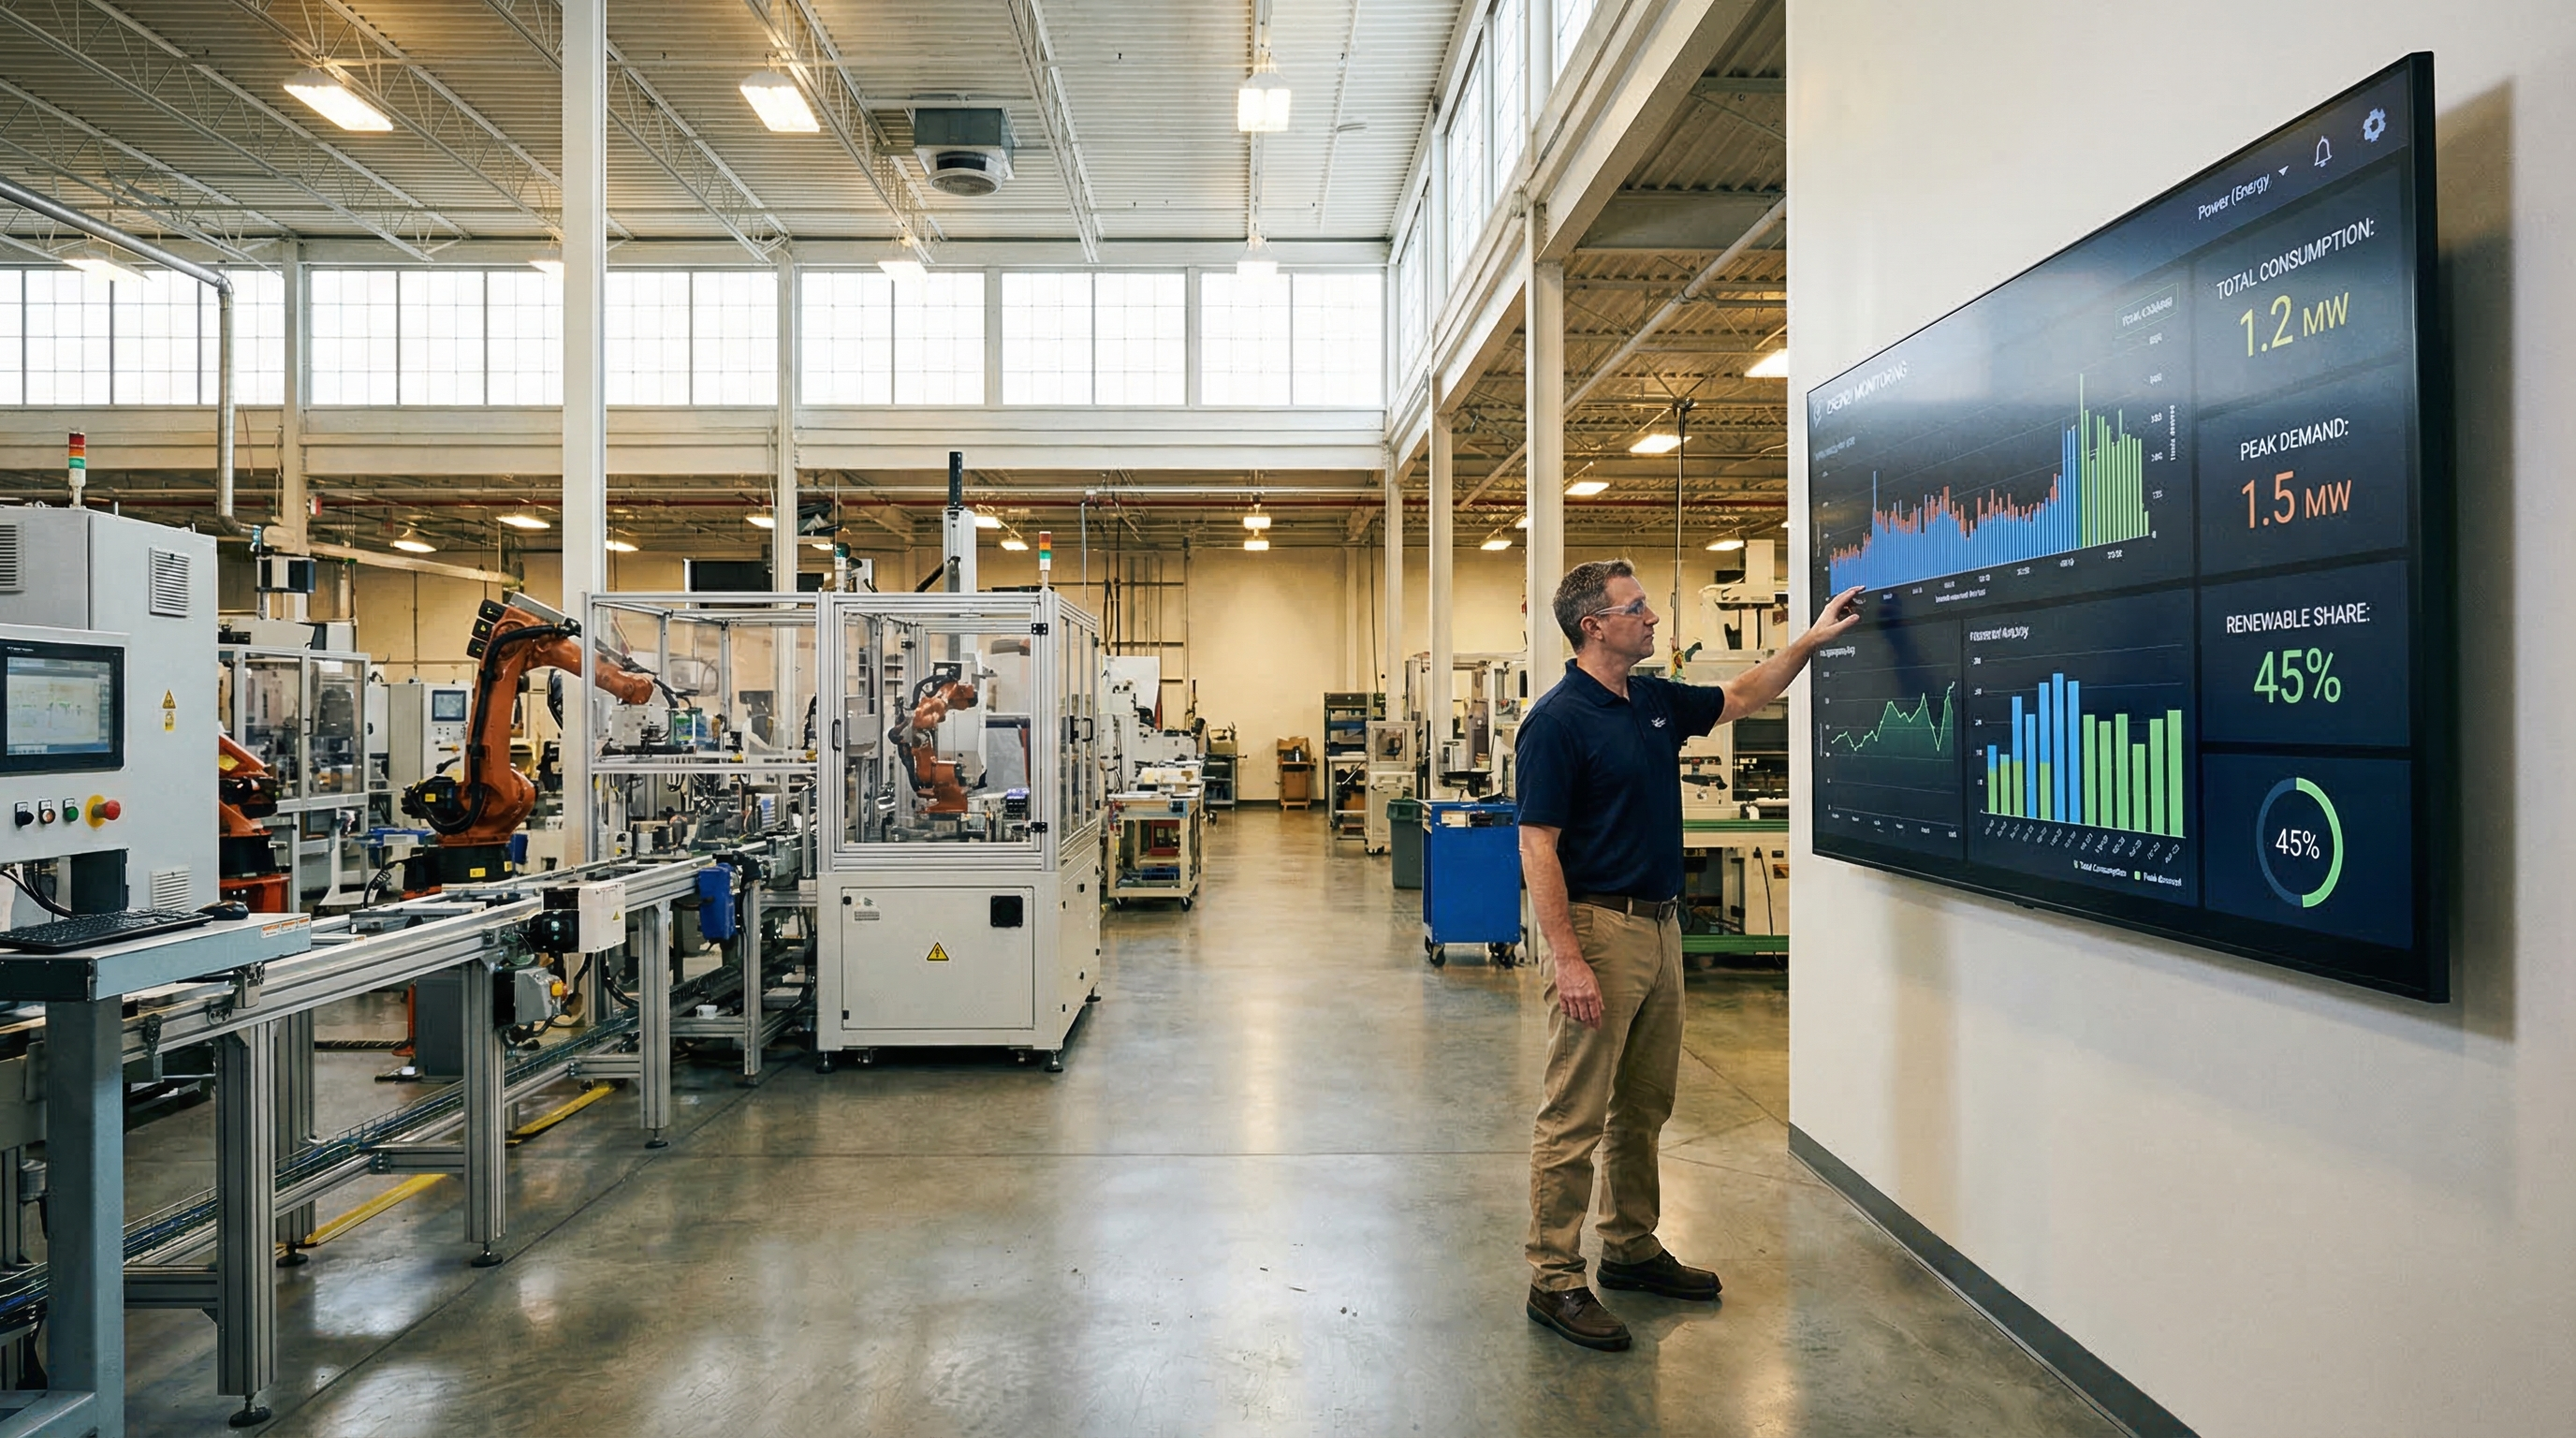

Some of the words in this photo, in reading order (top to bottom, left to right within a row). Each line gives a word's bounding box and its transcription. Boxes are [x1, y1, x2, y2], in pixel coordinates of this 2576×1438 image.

[2198, 195, 2231, 221] Power
[2216, 268, 2258, 301] TOTAL
[2259, 217, 2376, 283] CONSUMPTION:
[2238, 295, 2294, 358] 1.2
[2302, 291, 2350, 338] MW
[2240, 433, 2277, 462] PEAK
[2279, 418, 2350, 451] DEMAND:
[2241, 470, 2296, 530] 1.5
[2305, 479, 2352, 520] MW
[2226, 608, 2311, 635] RENEWABLE
[2313, 602, 2371, 627] SHARE:
[2253, 646, 2342, 705] 45%
[2275, 828, 2321, 860] 45%
